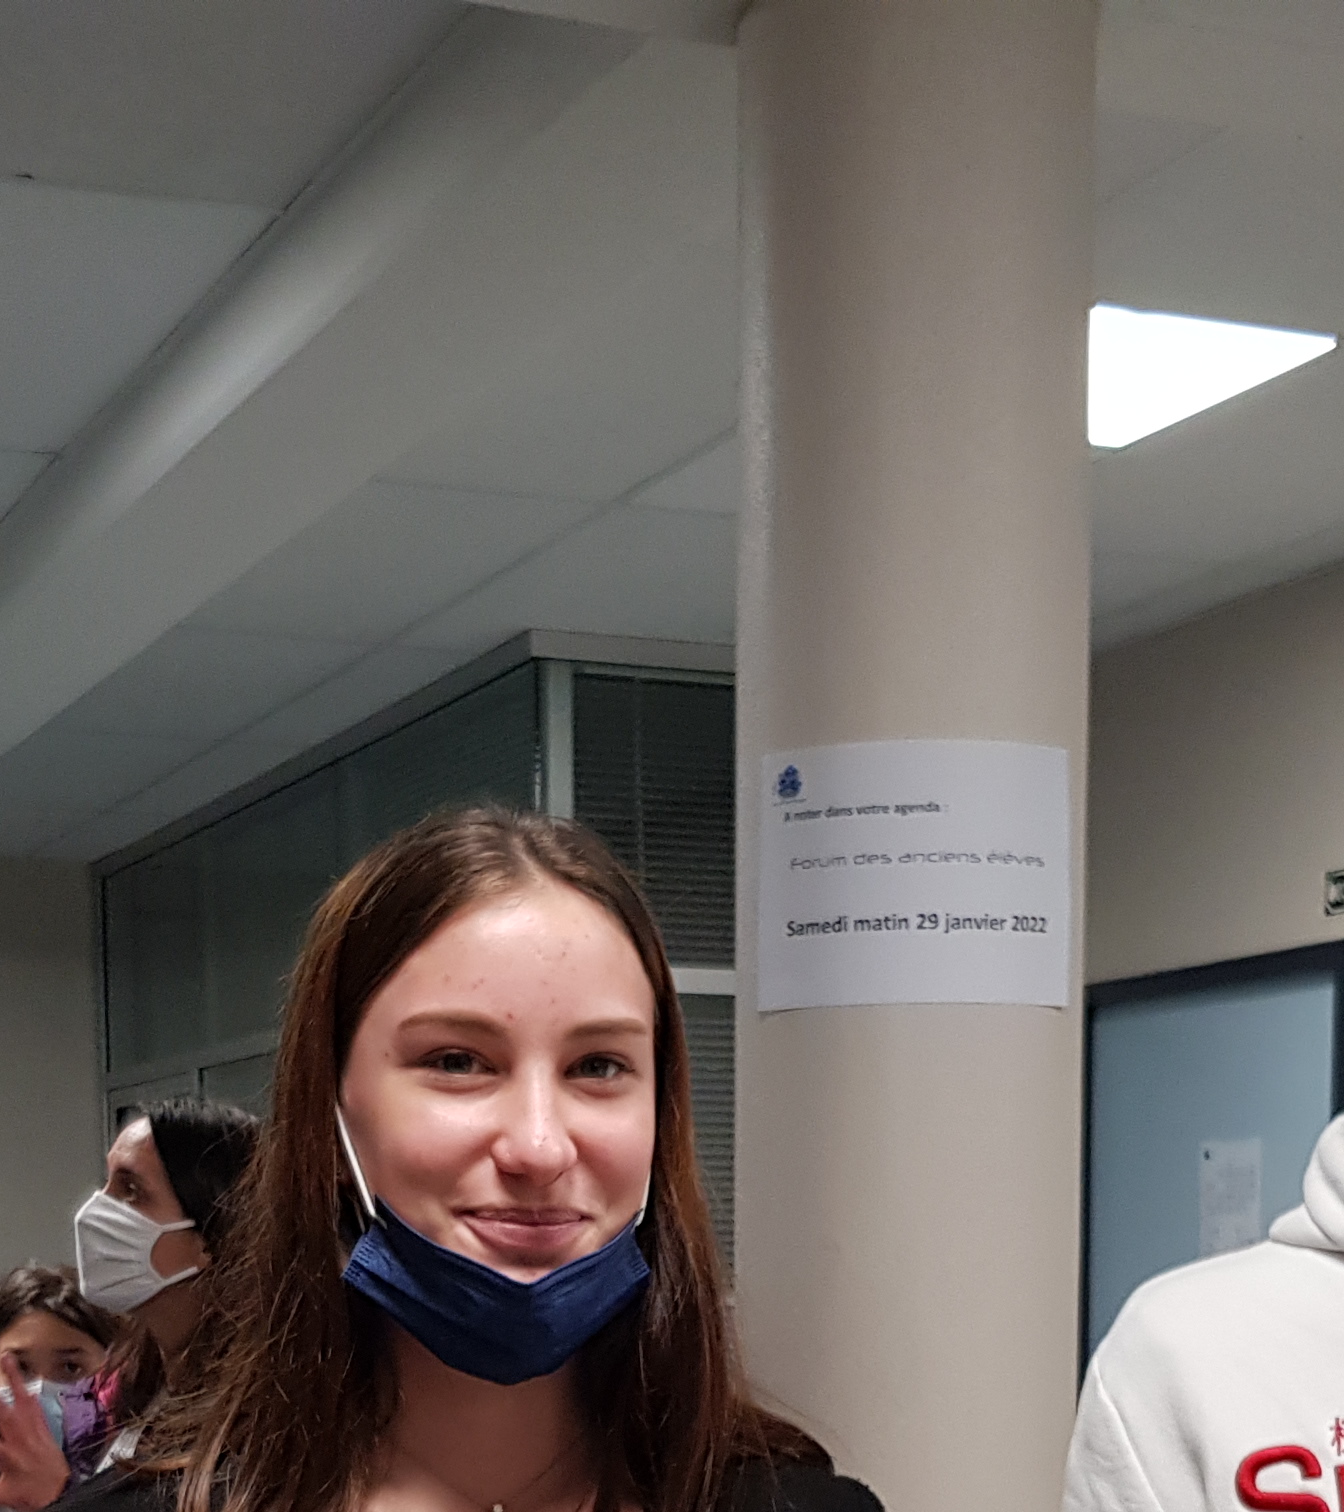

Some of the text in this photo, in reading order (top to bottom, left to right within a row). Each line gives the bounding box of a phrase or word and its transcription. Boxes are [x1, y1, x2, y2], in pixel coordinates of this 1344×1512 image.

[824, 806, 853, 819] dans
[856, 804, 890, 816] votre
[893, 801, 941, 817] agenda
[790, 856, 848, 870] Forum
[853, 853, 893, 866] des
[898, 852, 982, 864] anciens
[786, 912, 1048, 937] Samedi matin 29 janvier 2022
